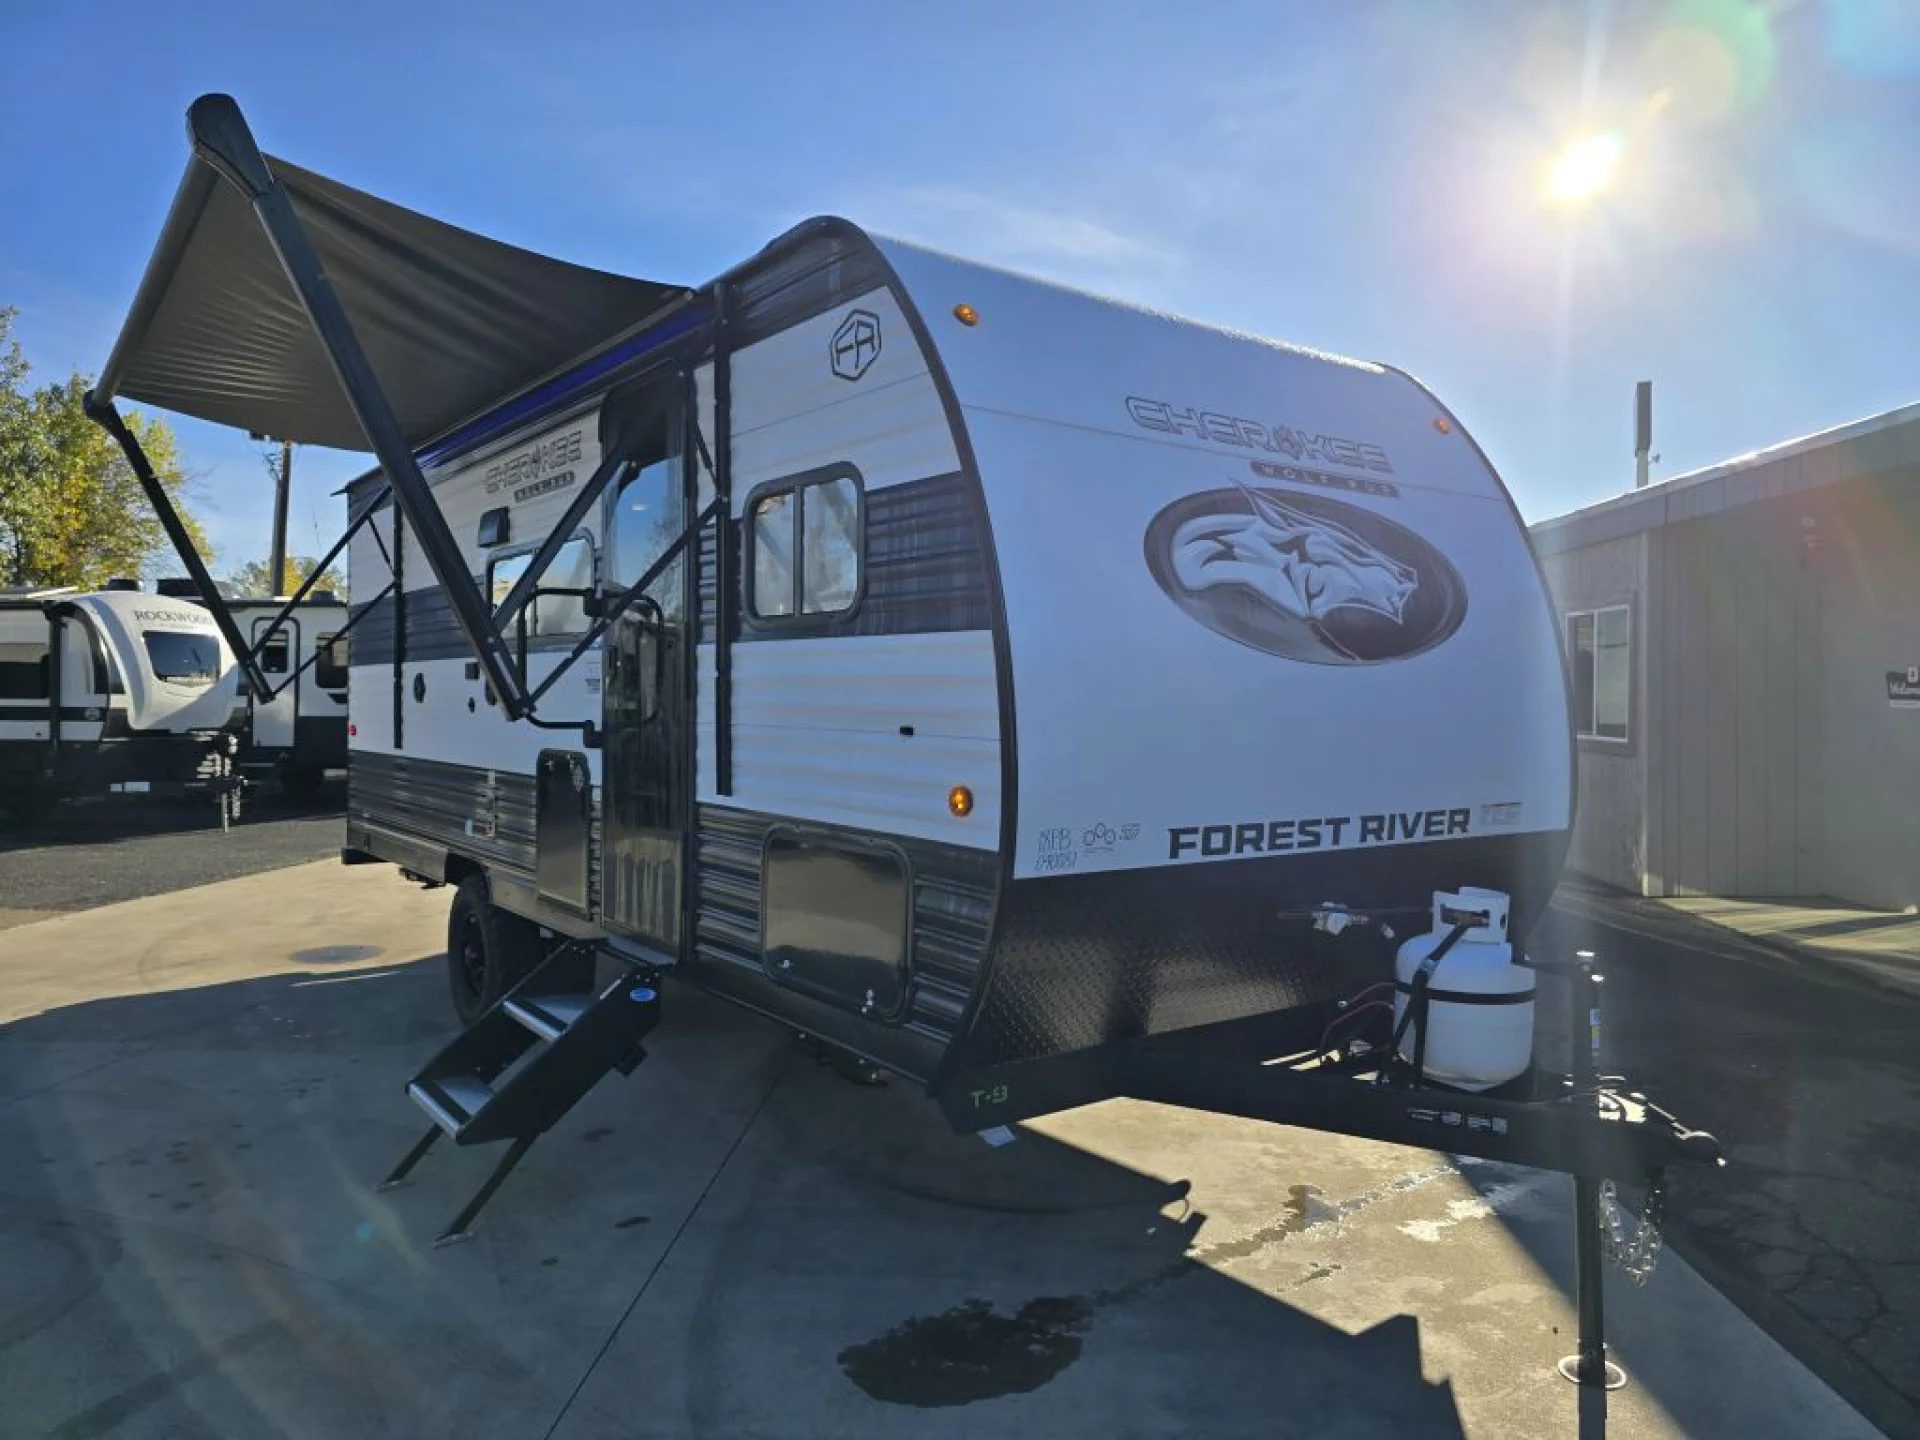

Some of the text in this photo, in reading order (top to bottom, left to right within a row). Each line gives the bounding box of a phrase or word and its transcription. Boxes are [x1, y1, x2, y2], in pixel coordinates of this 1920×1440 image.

[1124, 395, 1395, 473] CHEROKEE
[1168, 817, 1350, 860] FOREST
[1359, 808, 1471, 843] RIVER
